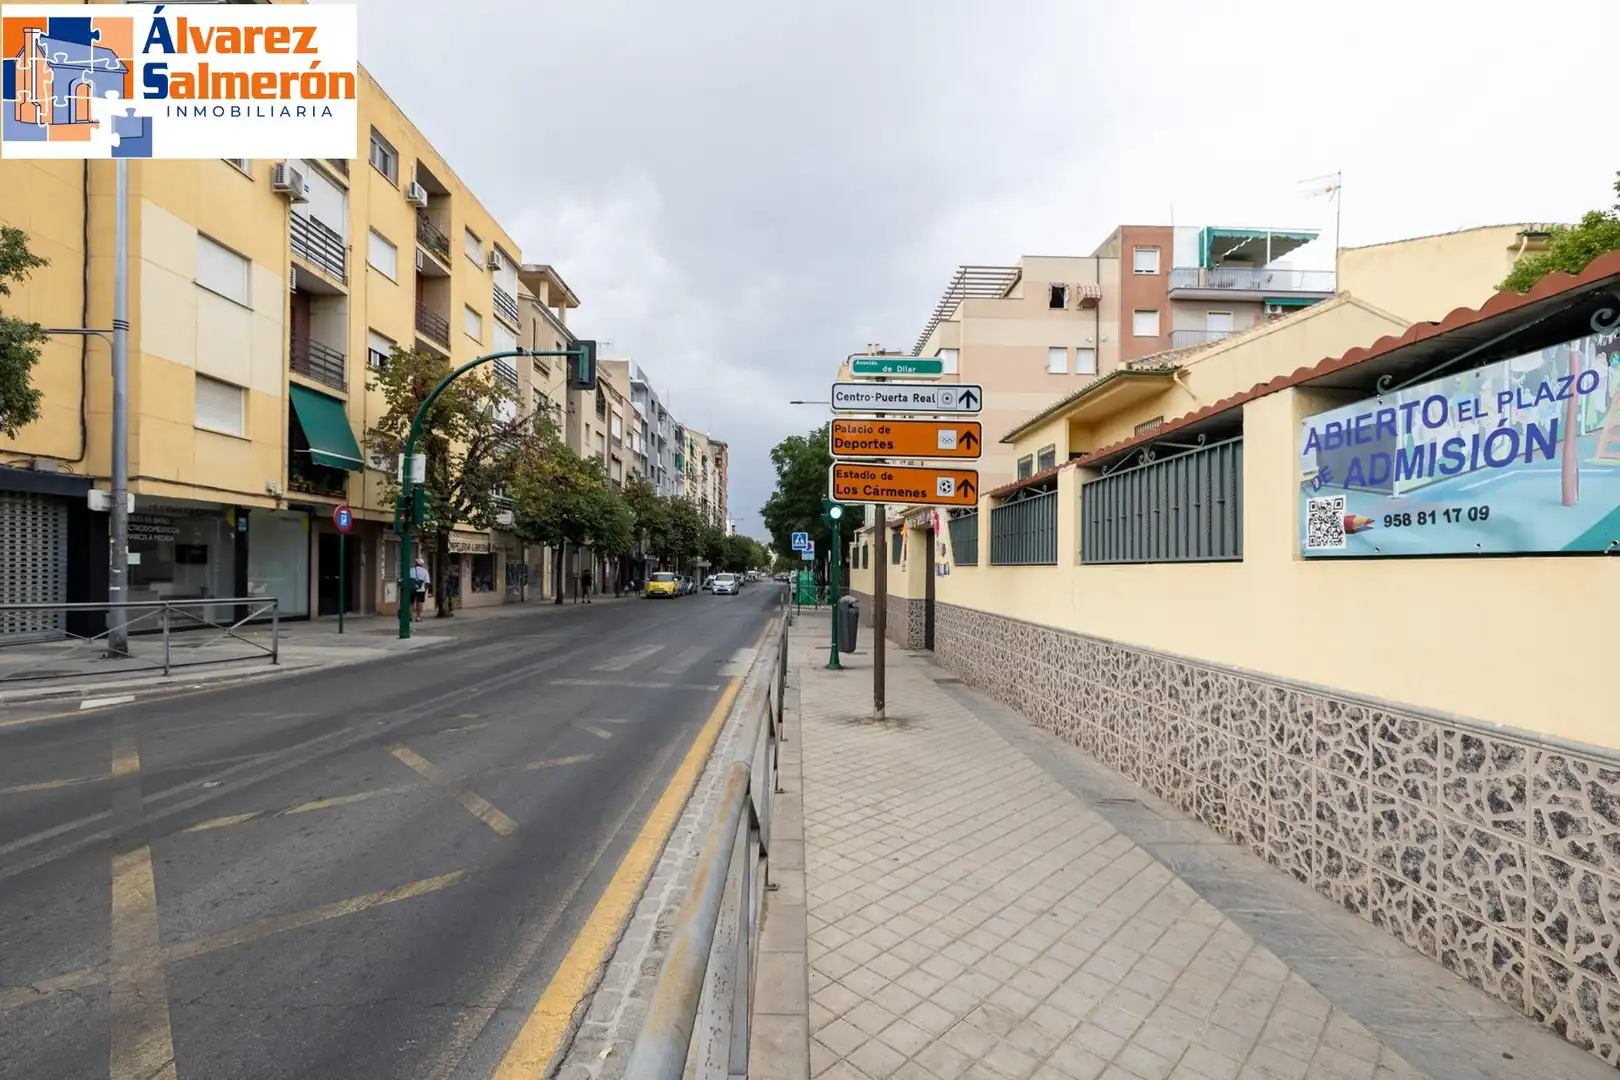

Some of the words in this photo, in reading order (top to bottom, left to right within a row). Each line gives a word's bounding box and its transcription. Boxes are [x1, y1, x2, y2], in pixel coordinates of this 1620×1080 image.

[882, 365, 893, 373] de
[912, 393, 936, 403] Real
[1303, 394, 1449, 455] ABIERTO
[1458, 399, 1488, 423] EL
[1497, 369, 1600, 414] PLAZO
[834, 424, 874, 434] Palacio
[878, 425, 891, 434] de
[834, 437, 894, 450] Deportes
[1309, 465, 1334, 493] DE
[1343, 416, 1559, 490] ADMISIÓN
[836, 470, 876, 480] Estadio
[880, 471, 894, 481] de
[836, 484, 858, 495] Los
[863, 485, 927, 498] Cármenes
[1383, 513, 1412, 528] 958
[1417, 511, 1436, 526] 81
[1443, 508, 1461, 524] 17
[1467, 505, 1490, 522] 09
